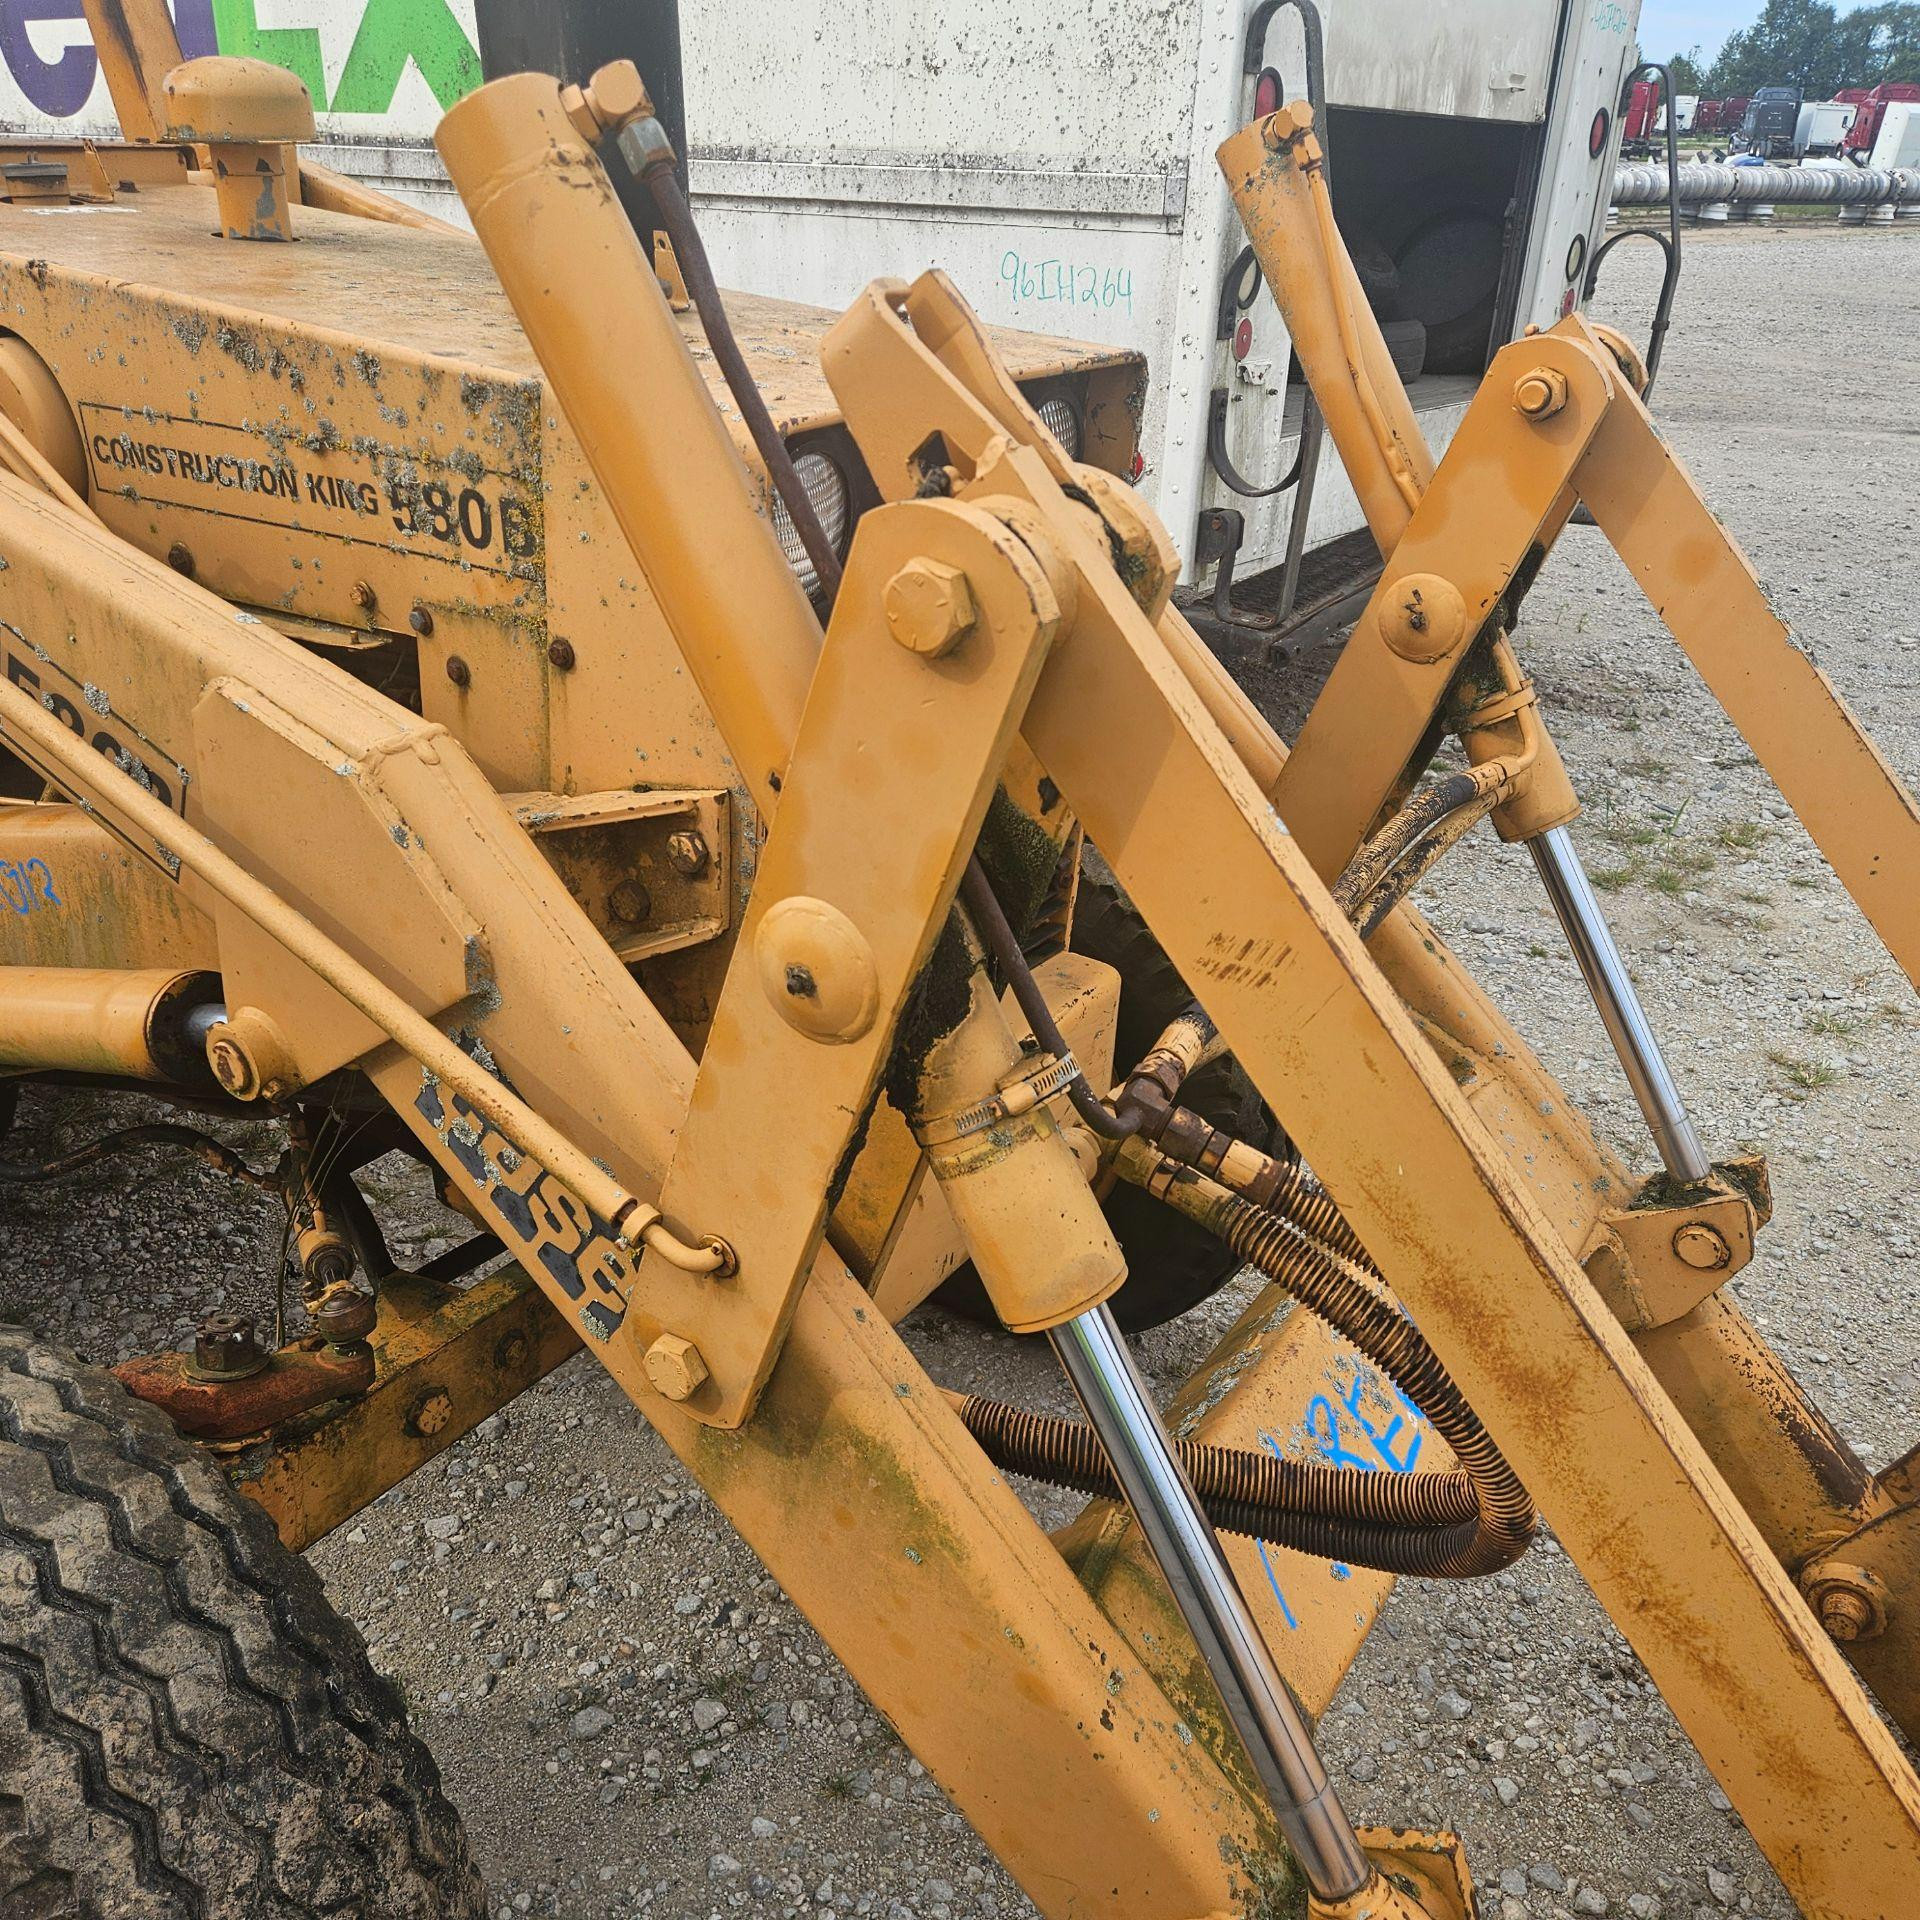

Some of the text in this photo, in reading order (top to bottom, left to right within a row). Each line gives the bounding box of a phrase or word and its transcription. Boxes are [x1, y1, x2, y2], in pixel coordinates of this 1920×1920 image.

[1001, 251, 1132, 318] 96IH264
[93, 433, 299, 501] CONSTRUCTION
[306, 472, 379, 516] KING
